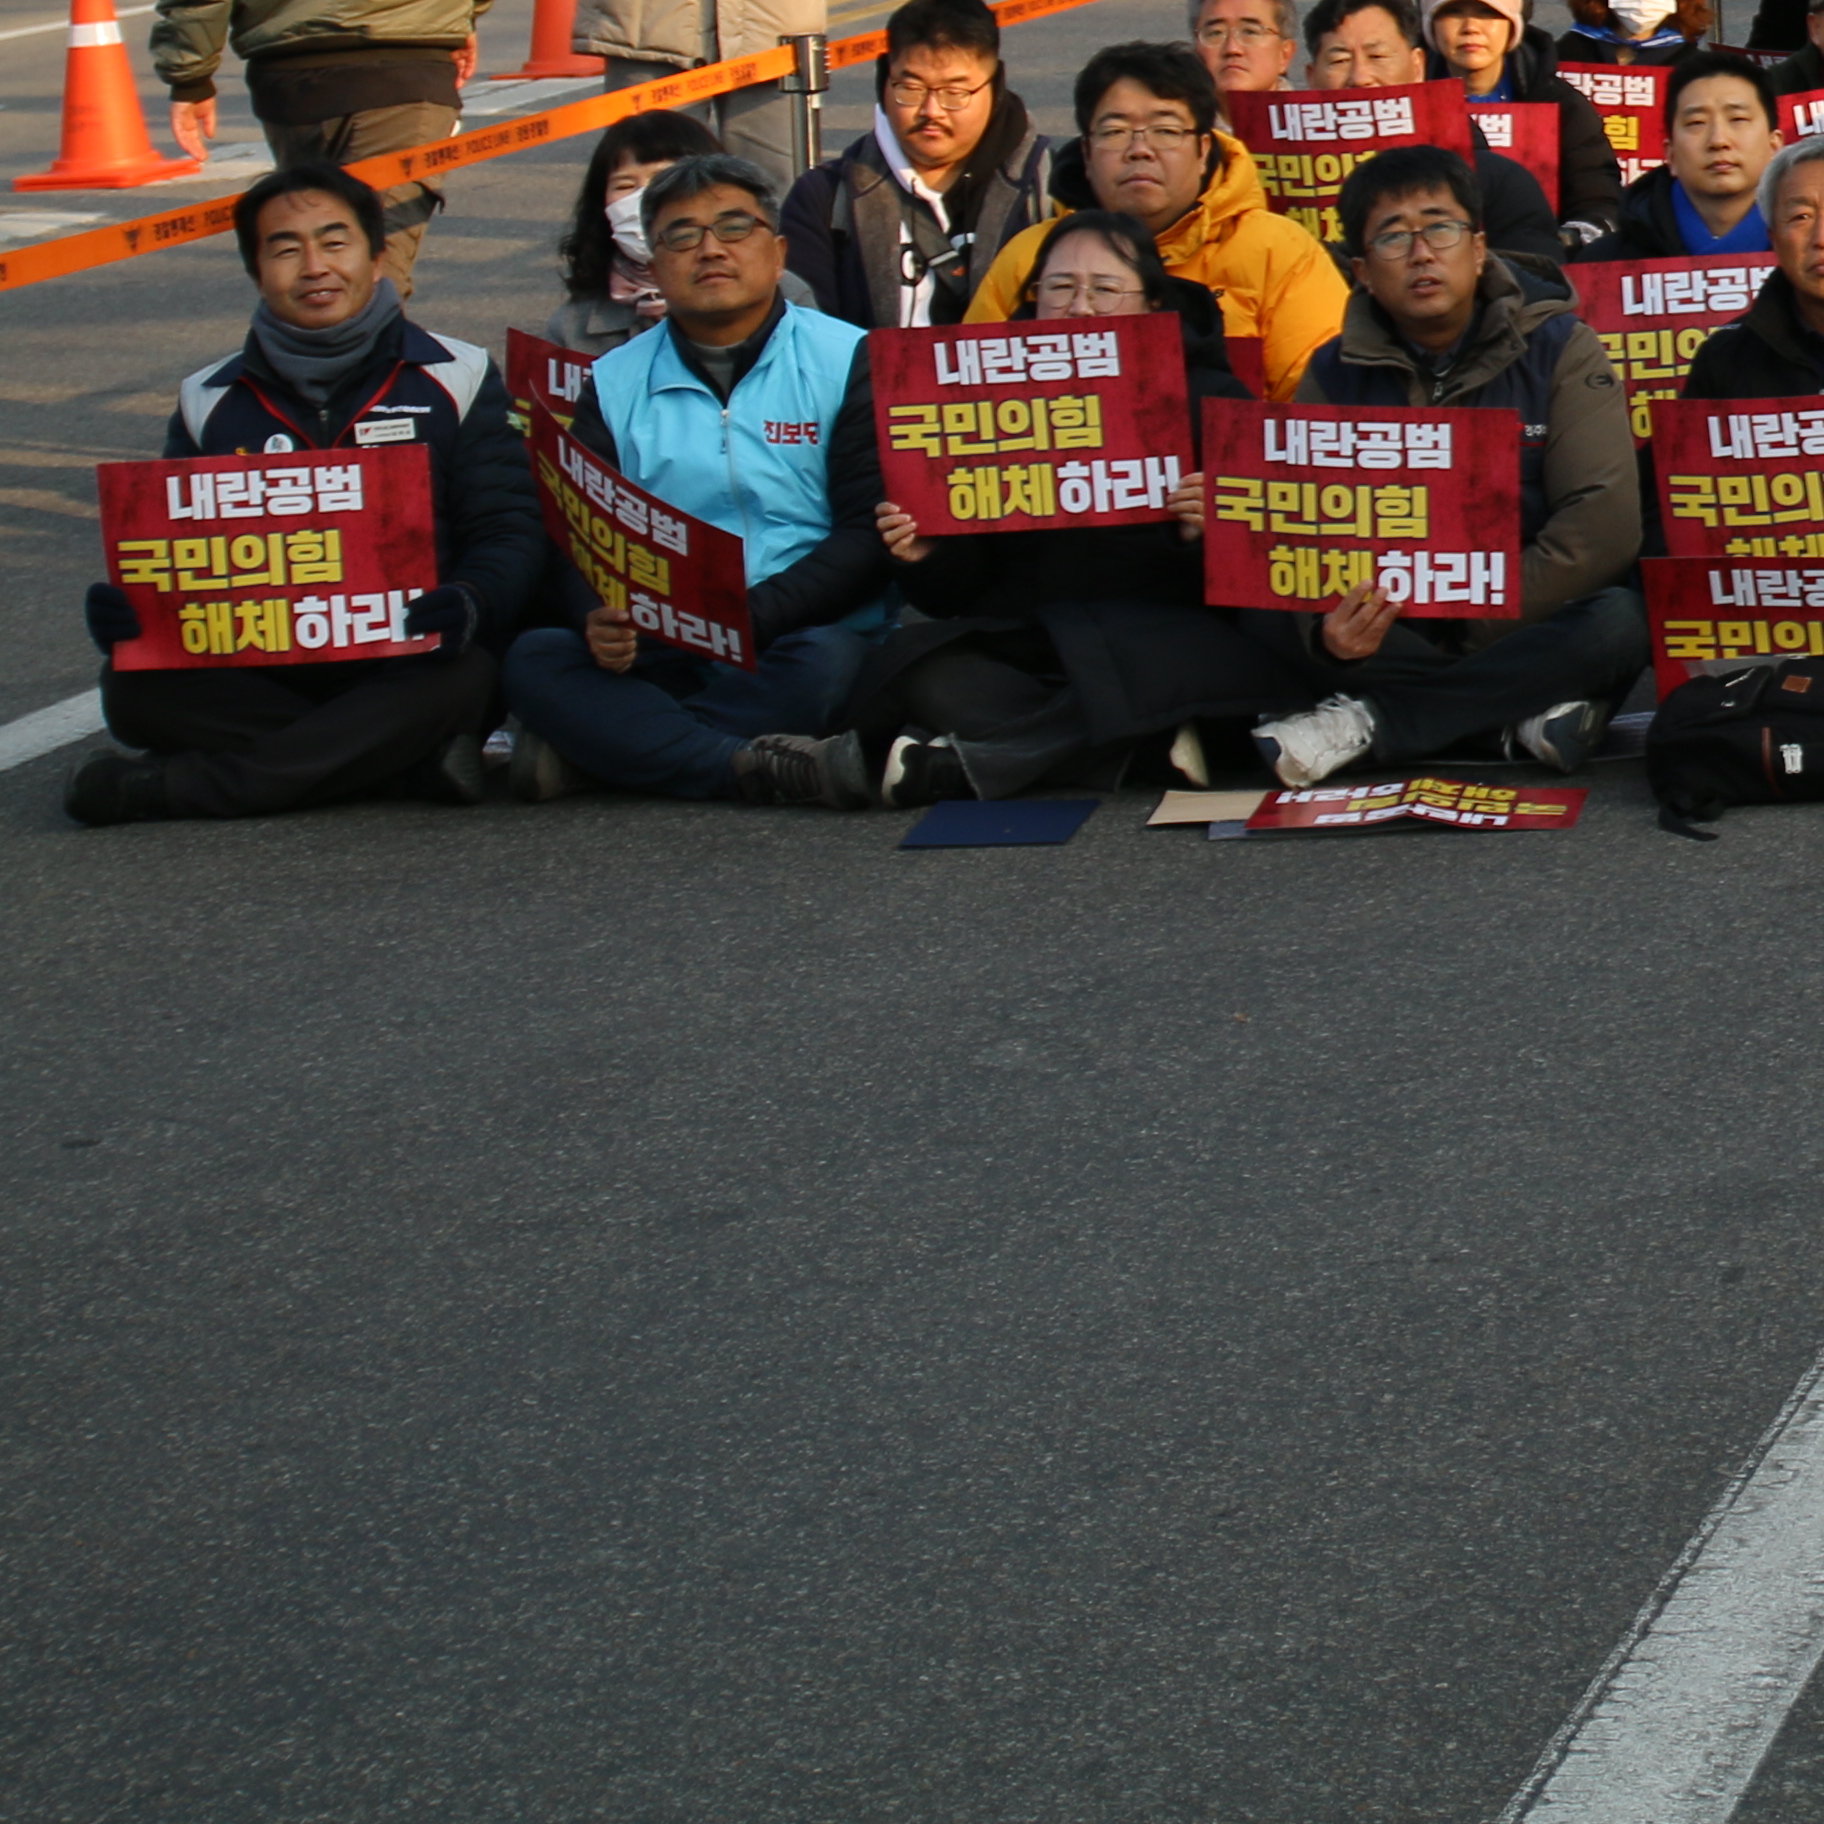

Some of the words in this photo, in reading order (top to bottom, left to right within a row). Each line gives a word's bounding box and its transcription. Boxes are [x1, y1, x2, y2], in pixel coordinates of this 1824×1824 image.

[1269, 97, 1414, 141] 내란공범
[933, 332, 1120, 386] 내란공범
[889, 395, 1102, 458] 국민의힘
[1264, 418, 1453, 469] 내란공범
[167, 465, 363, 520] 내란공범
[558, 441, 689, 556] 내란공범
[946, 456, 1179, 522] 해체하라!
[1216, 477, 1428, 538] 국민의힘
[536, 449, 670, 596] 국민의힘
[118, 529, 342, 592] 국민의힘
